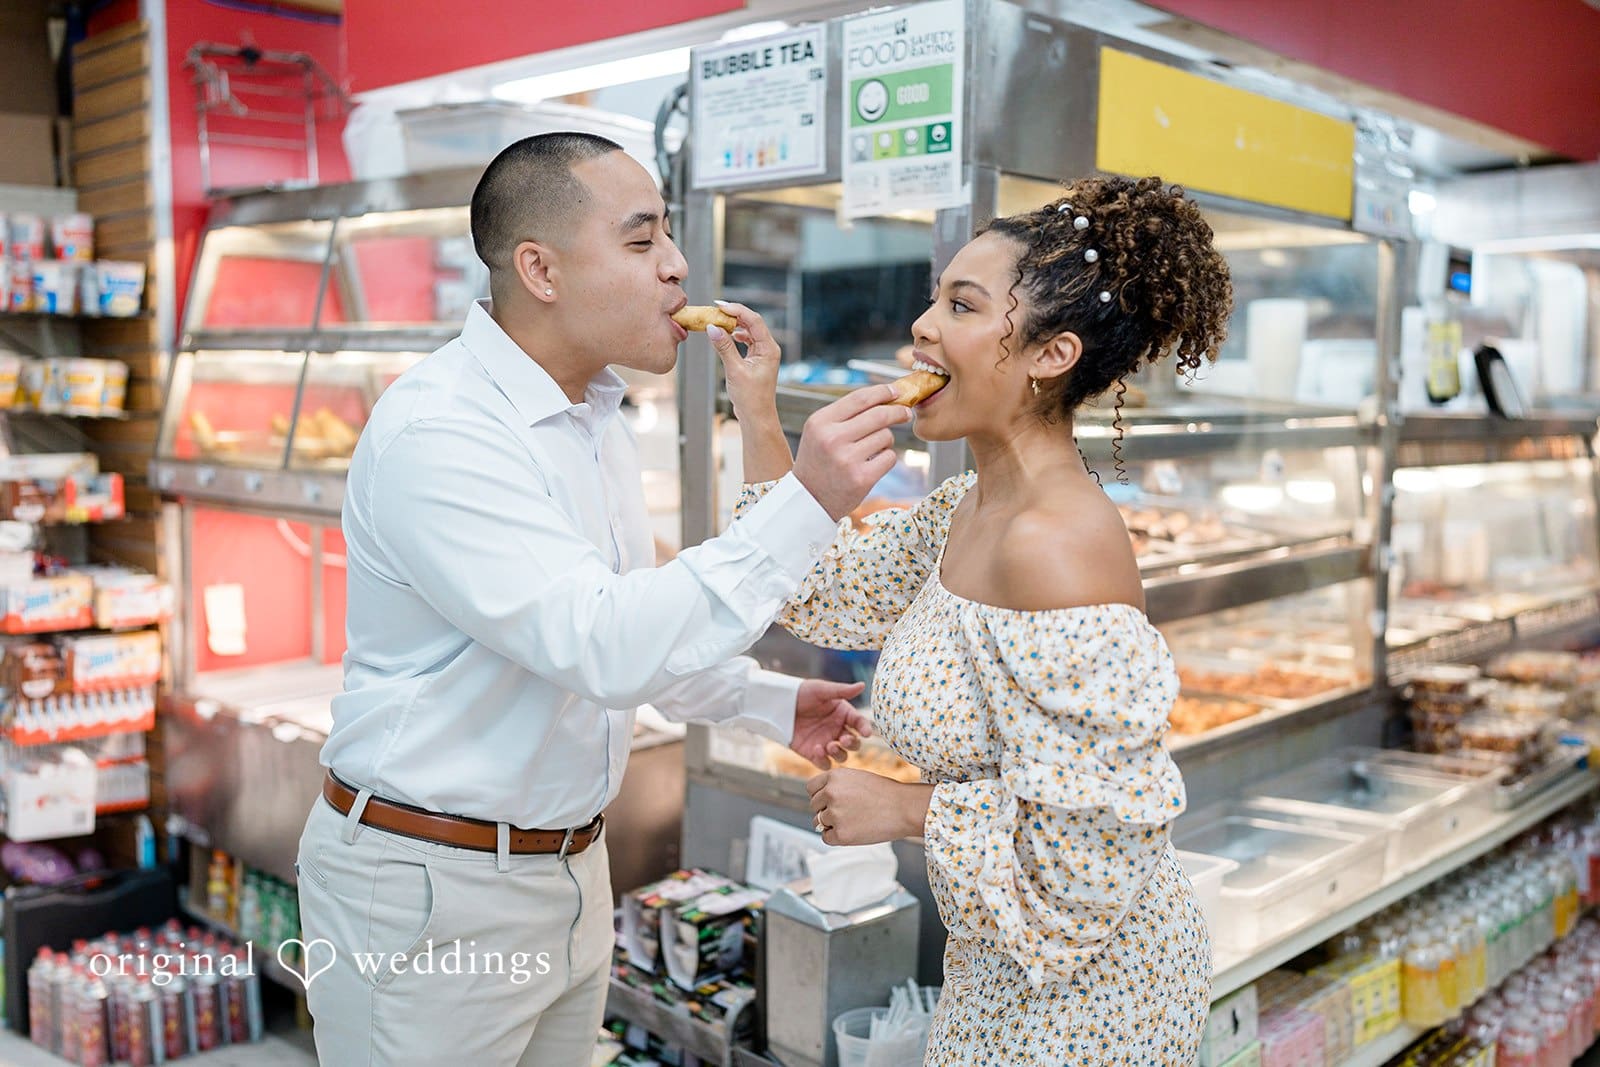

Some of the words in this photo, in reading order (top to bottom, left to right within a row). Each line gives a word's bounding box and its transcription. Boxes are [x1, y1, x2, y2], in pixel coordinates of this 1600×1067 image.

[703, 48, 773, 79] BUBBLE
[781, 40, 814, 65] TEA
[848, 39, 907, 70] FOOD
